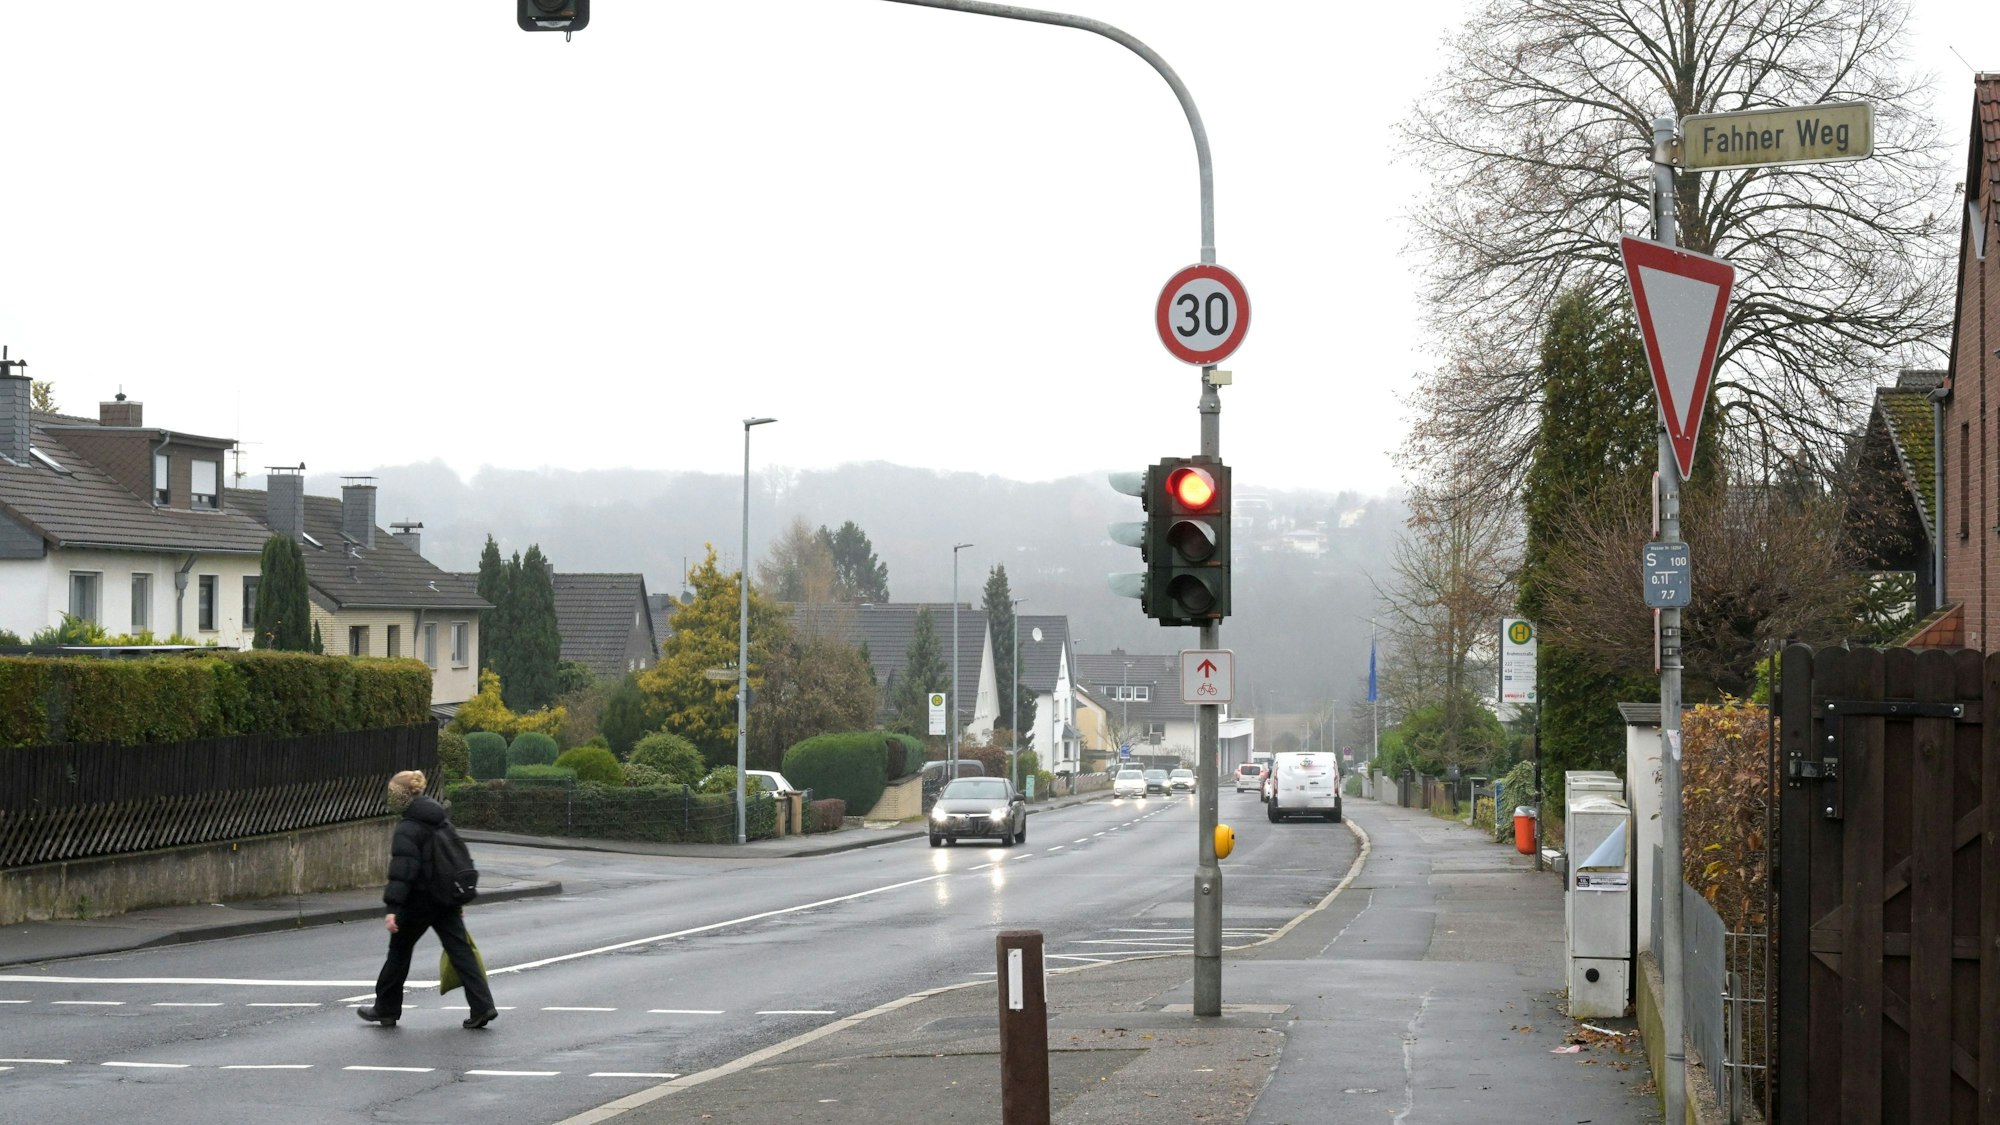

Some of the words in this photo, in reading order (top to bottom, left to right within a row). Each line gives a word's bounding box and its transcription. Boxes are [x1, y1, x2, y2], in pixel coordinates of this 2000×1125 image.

[1703, 124, 1784, 154] Fahner
[1796, 118, 1849, 152] Weg
[1176, 291, 1229, 337] 30
[1646, 553, 1656, 566] S
[1670, 557, 1687, 566] 100
[1515, 626, 1525, 640] H
